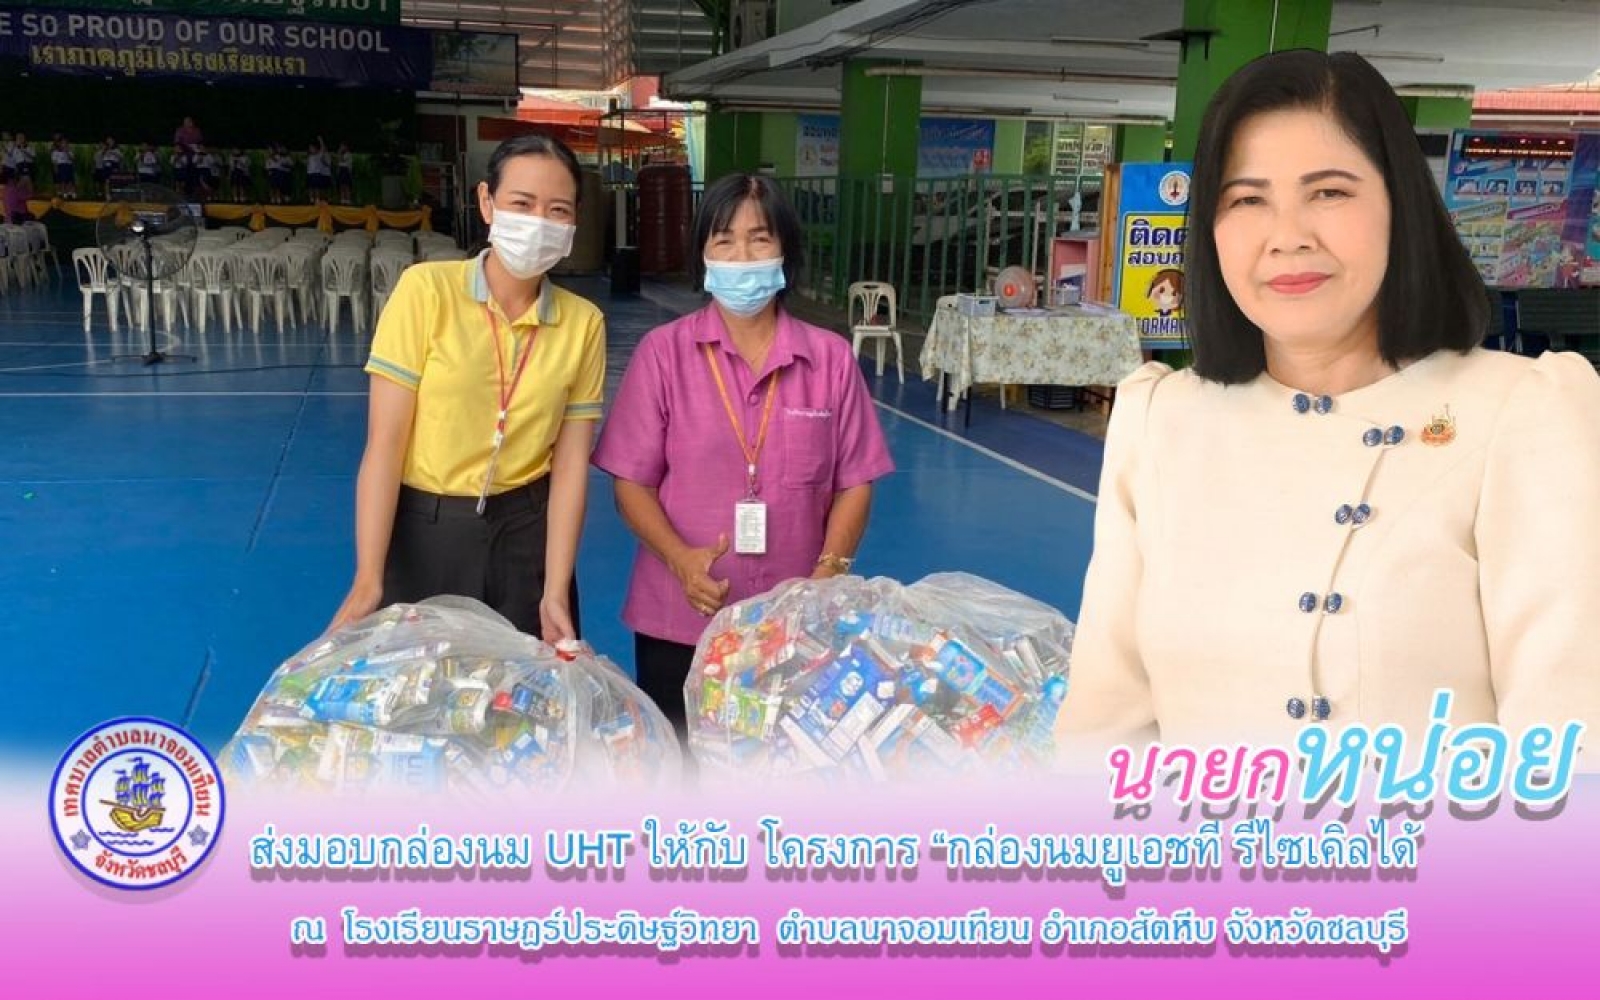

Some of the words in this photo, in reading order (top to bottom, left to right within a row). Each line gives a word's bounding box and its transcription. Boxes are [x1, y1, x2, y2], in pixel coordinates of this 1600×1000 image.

[21, 13, 58, 37] SO
[67, 14, 164, 41] PROUD
[175, 19, 210, 43] OF
[218, 22, 276, 47] OUR
[284, 25, 391, 53] SCHOOL
